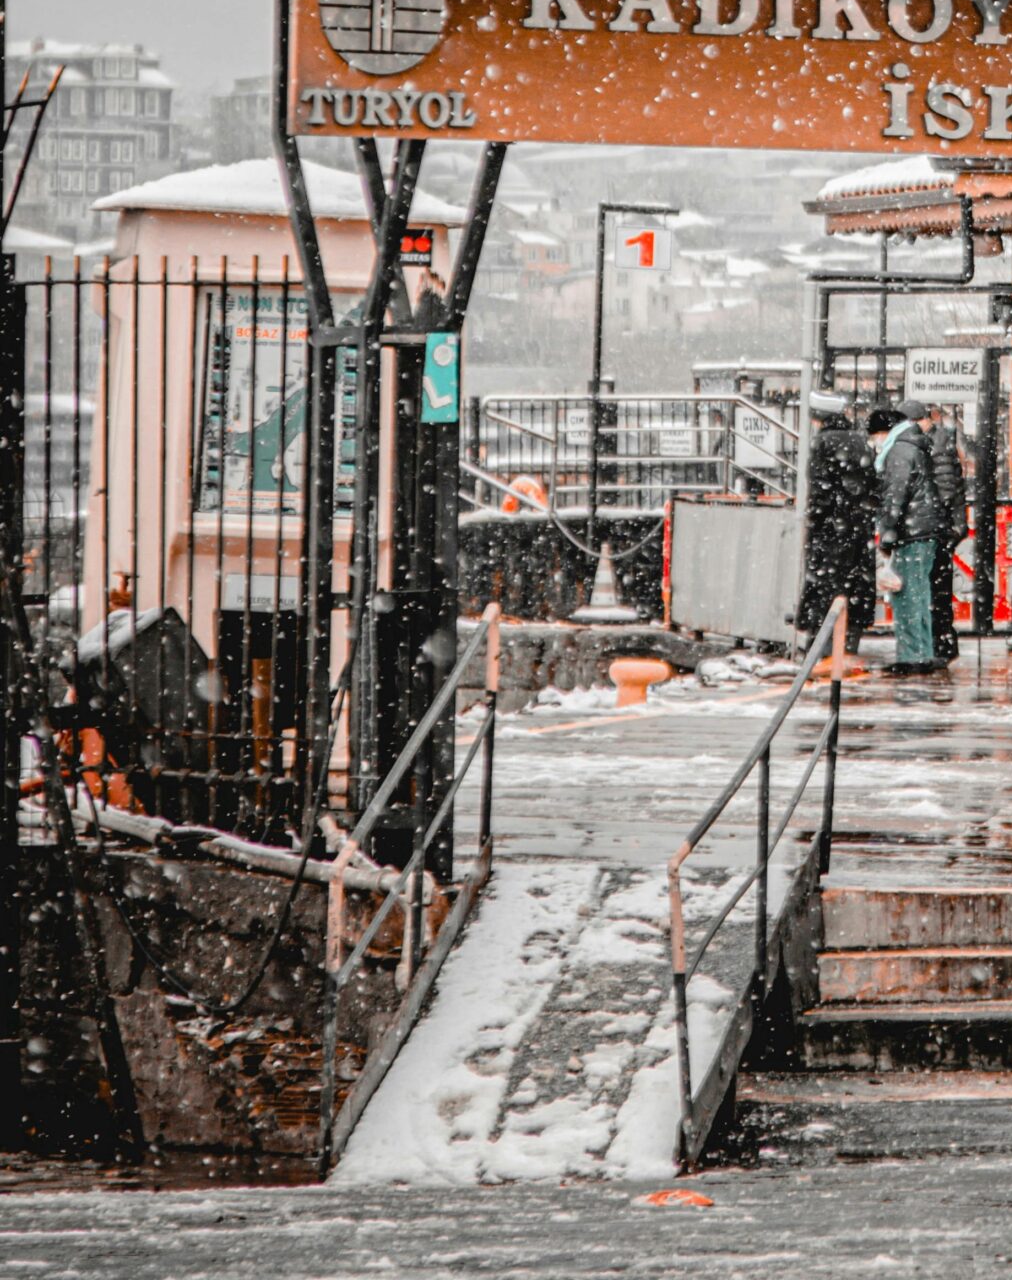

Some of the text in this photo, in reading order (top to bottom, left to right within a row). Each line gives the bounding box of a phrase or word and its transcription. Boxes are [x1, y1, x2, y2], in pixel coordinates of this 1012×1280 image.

[300, 88, 477, 129] TURYOL
[625, 230, 655, 268] 1
[912, 356, 979, 375] GİRİLMEZ
[928, 380, 978, 393] admittance)
